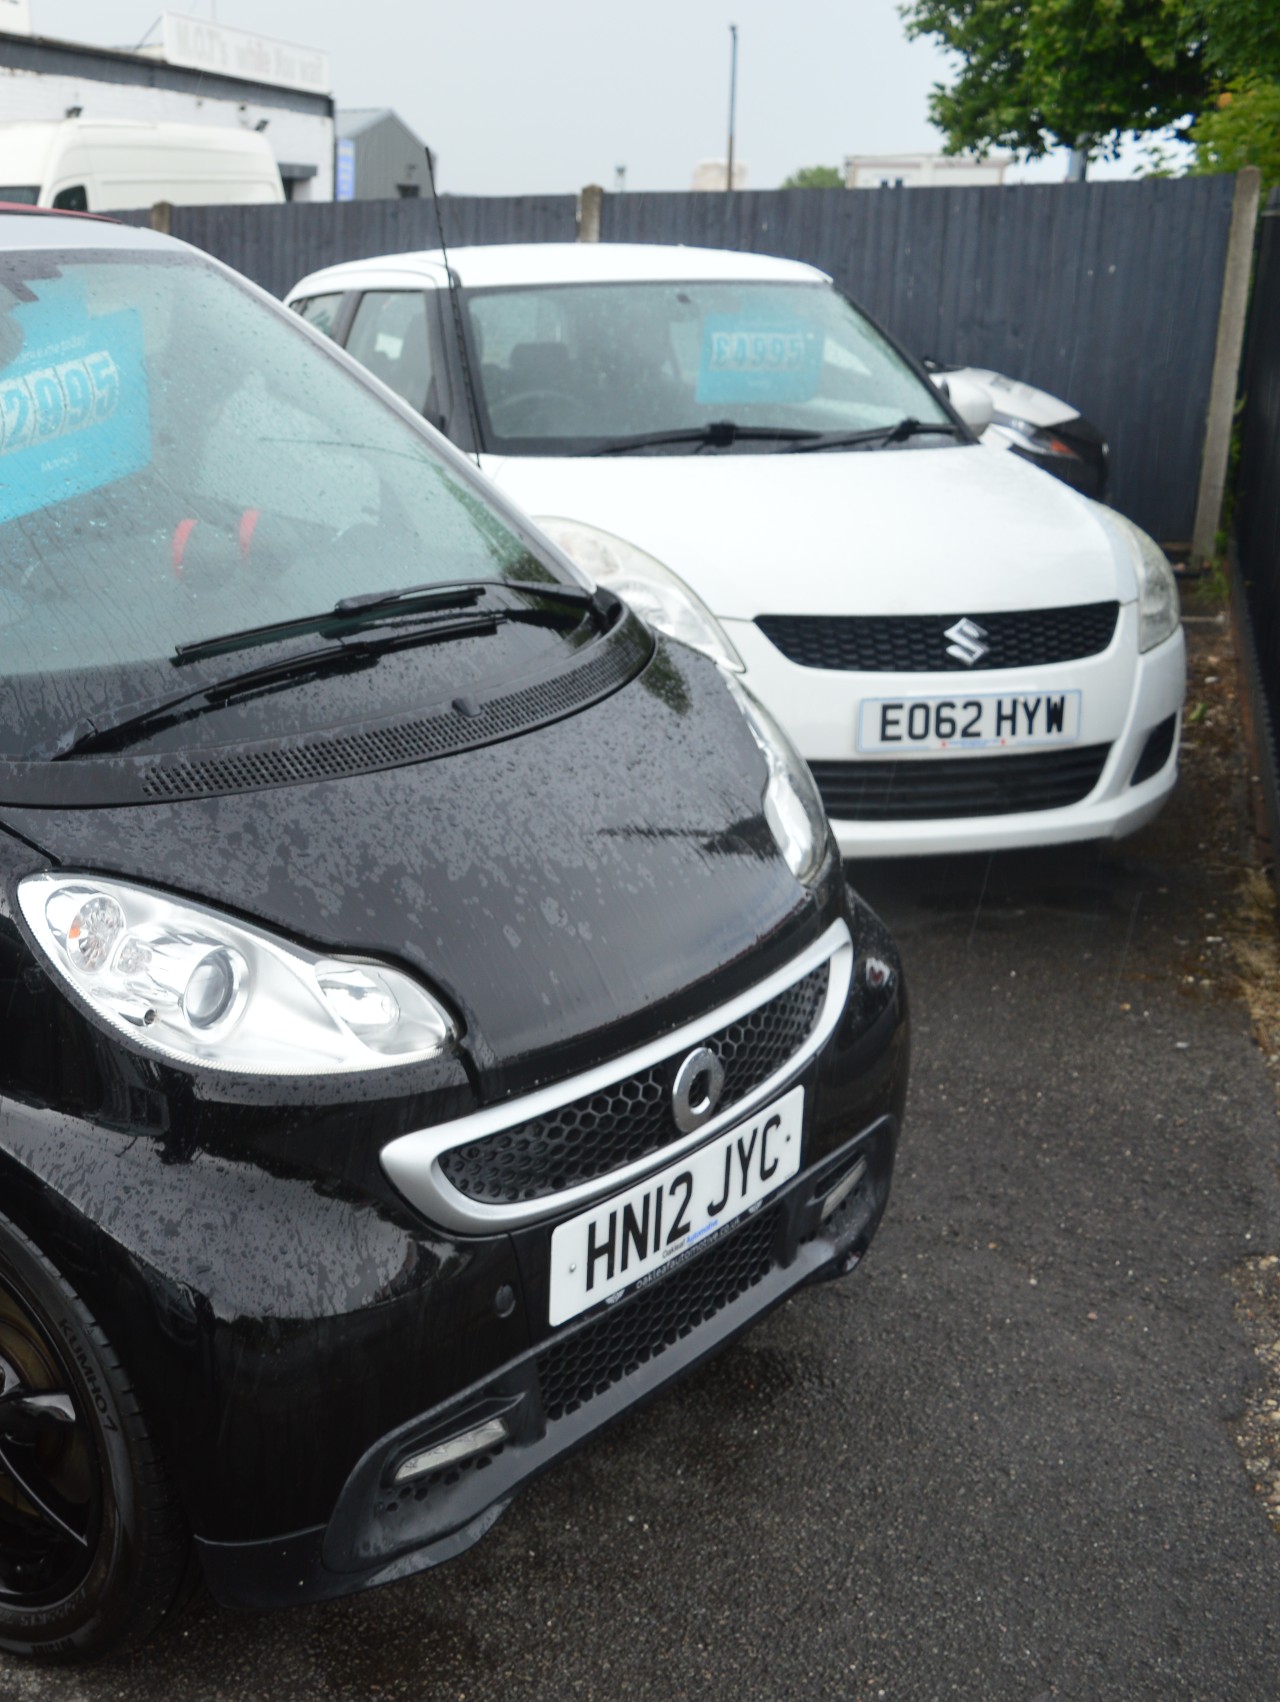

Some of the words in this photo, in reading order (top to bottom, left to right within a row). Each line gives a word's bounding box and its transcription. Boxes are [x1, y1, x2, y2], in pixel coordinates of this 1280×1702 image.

[880, 700, 982, 742] EO62
[996, 696, 1065, 737] HYW
[586, 1171, 693, 1292] HN12
[707, 1114, 781, 1217] JYC
[687, 1219, 719, 1244] Automotive
[60, 1318, 109, 1414] KUMHO
